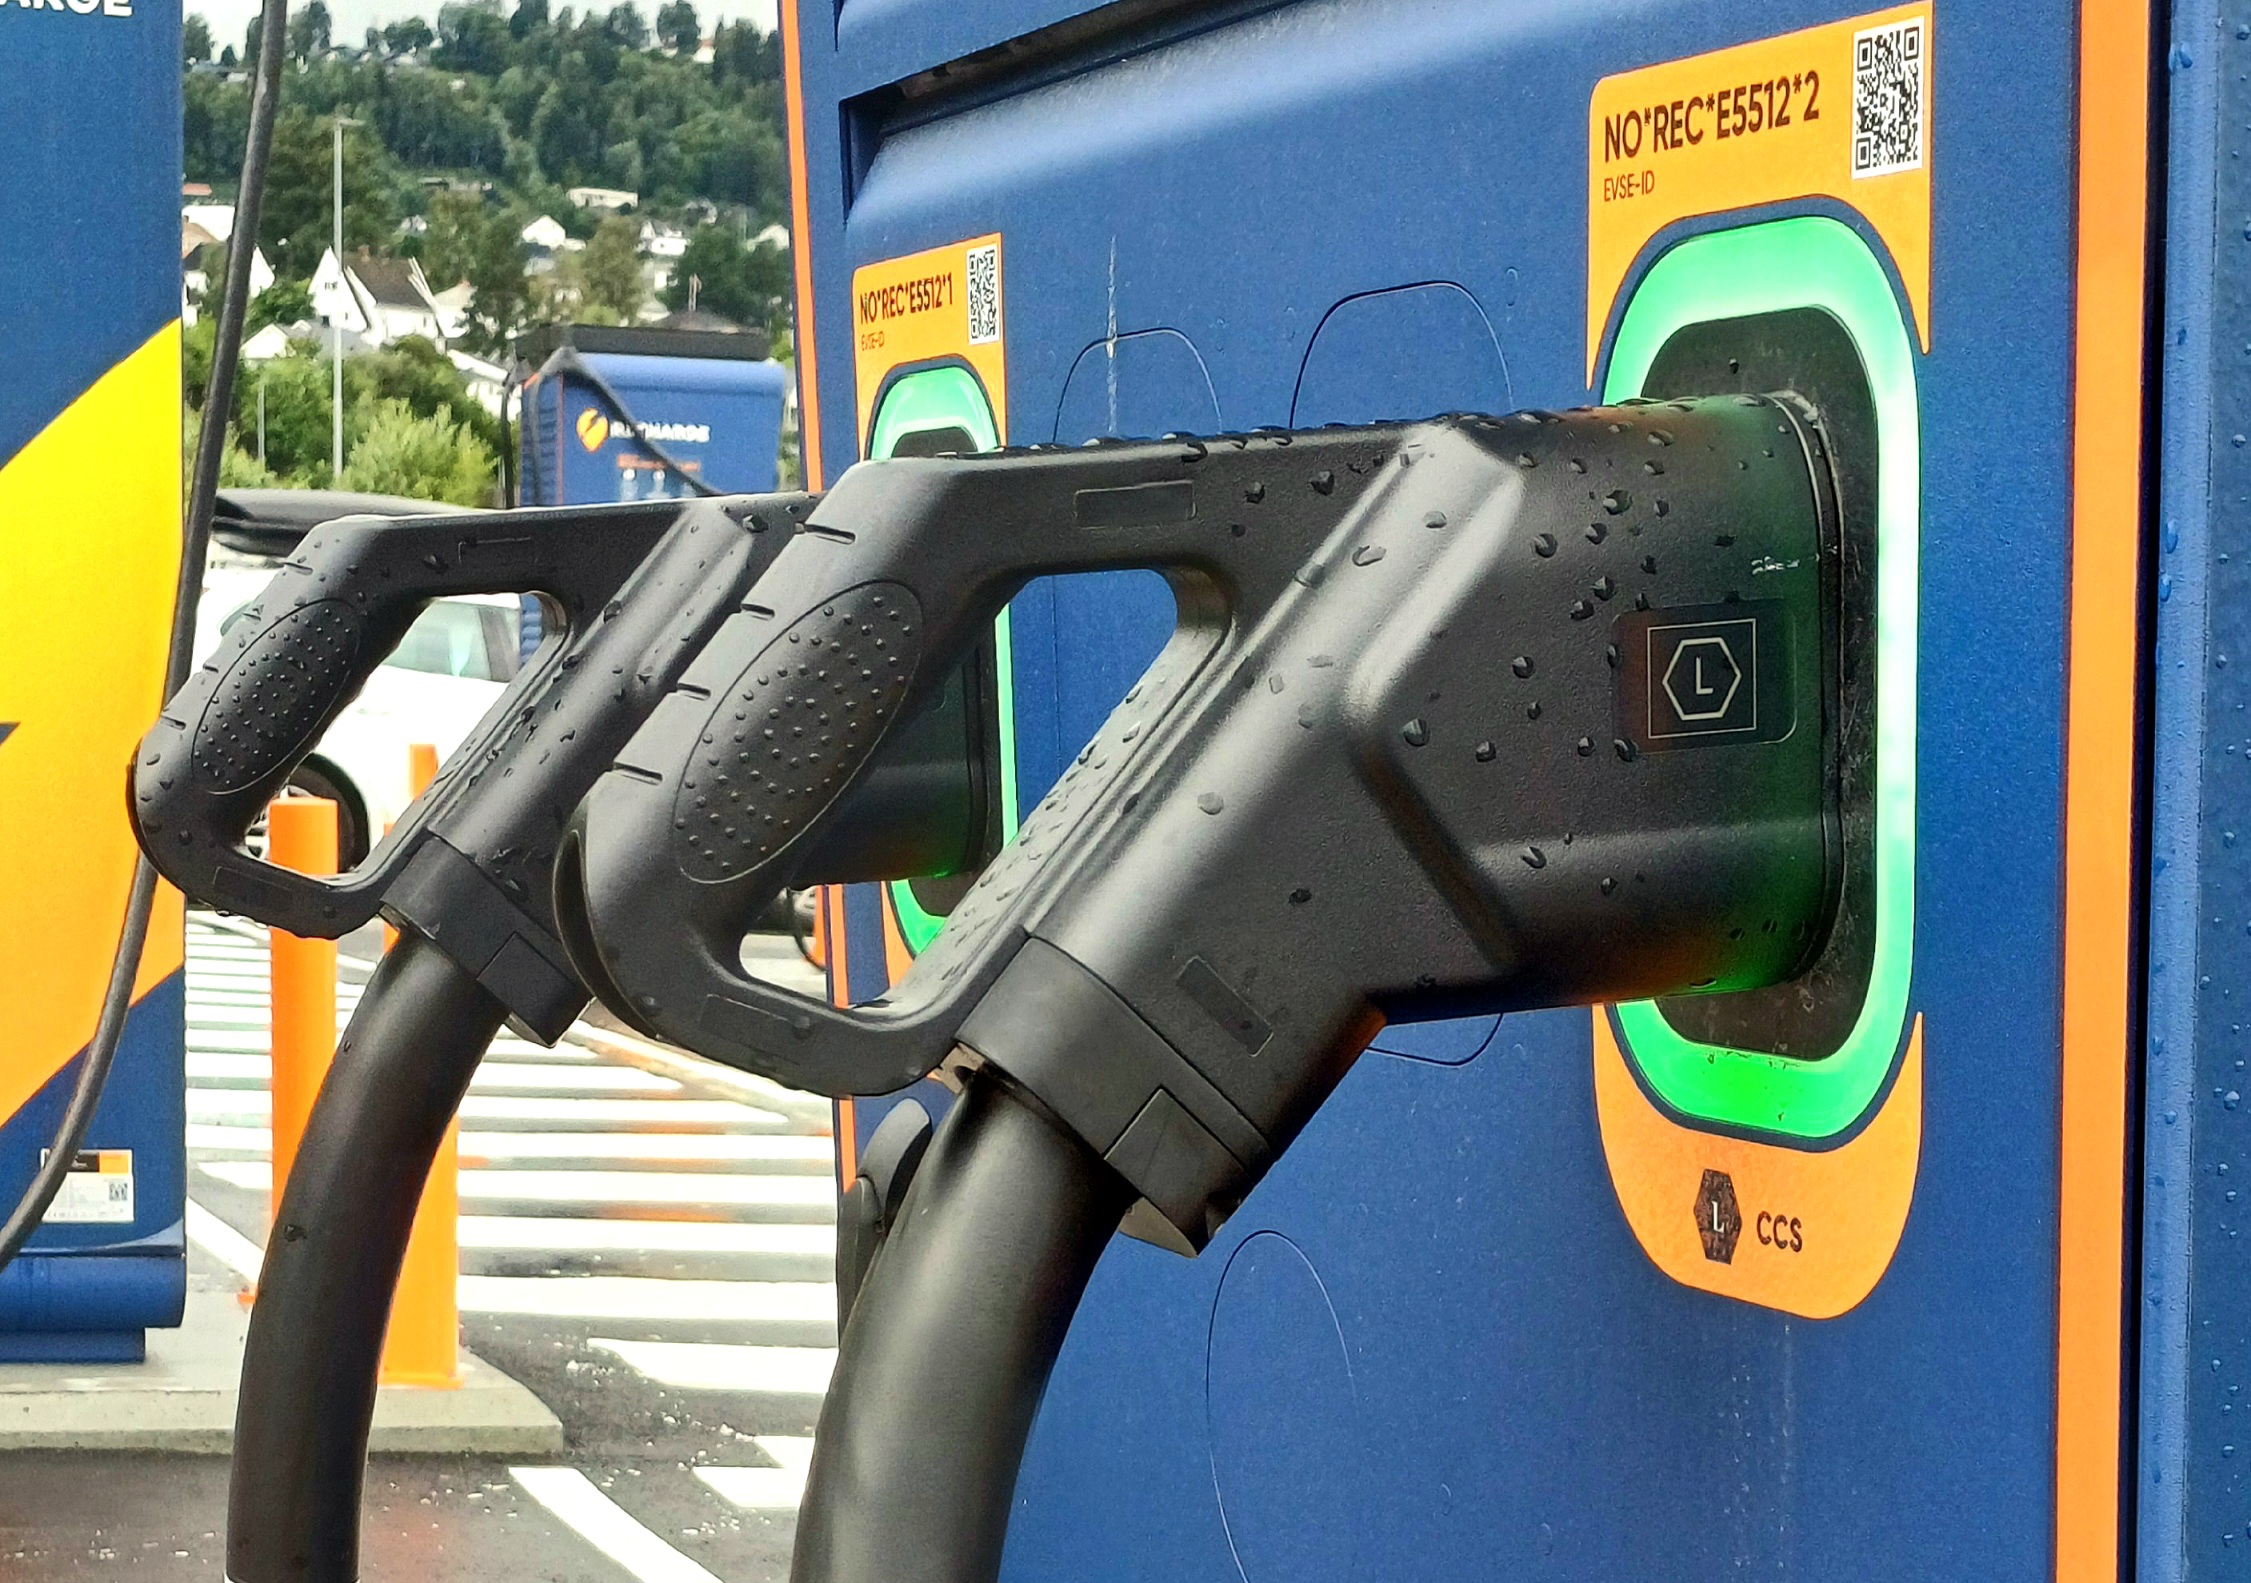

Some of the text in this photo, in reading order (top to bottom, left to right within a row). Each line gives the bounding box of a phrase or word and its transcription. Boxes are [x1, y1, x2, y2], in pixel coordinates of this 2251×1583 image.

[1604, 170, 1655, 202] EVSE-ID
[1695, 656, 1714, 695] L
[1711, 1200, 1803, 1253] L CCS
